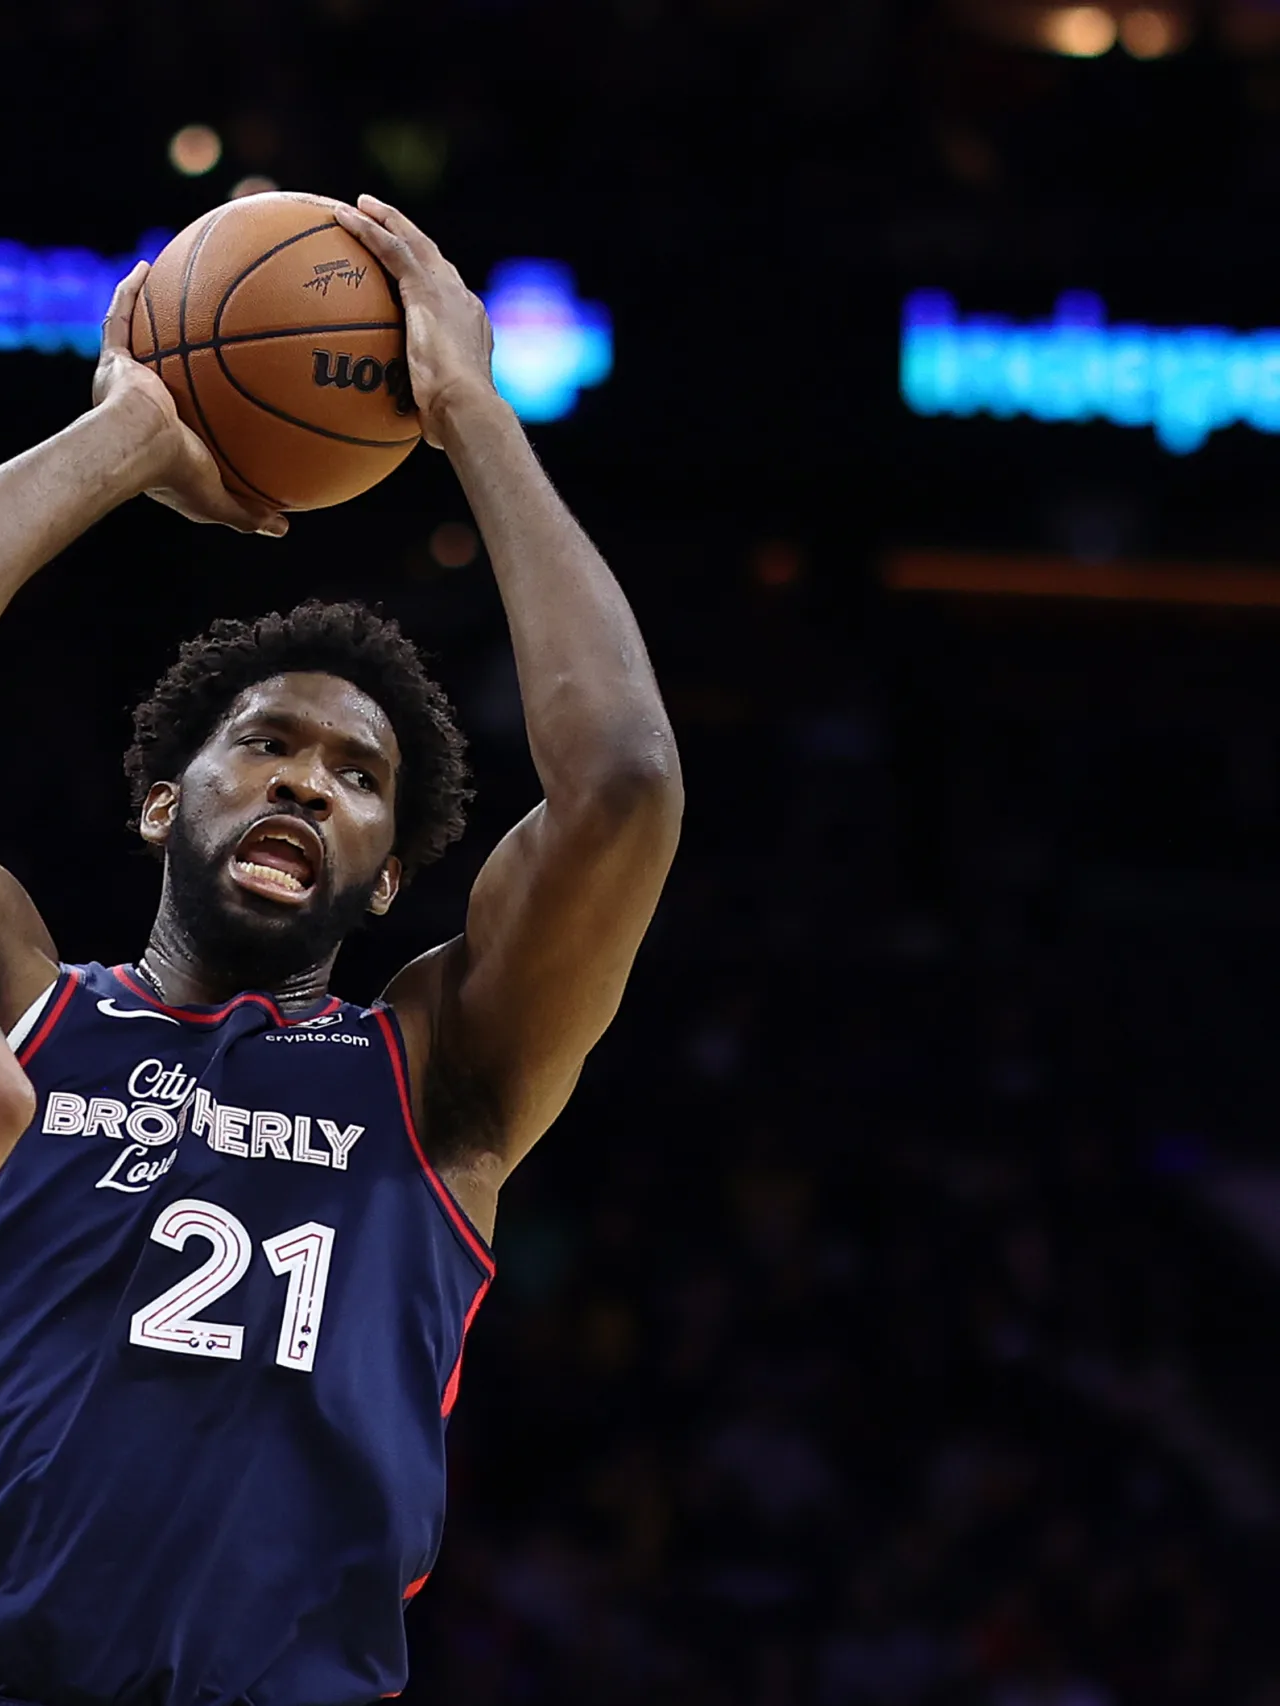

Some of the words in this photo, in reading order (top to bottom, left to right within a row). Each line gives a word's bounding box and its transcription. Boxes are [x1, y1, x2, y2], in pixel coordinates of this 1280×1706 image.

[265, 1032, 370, 1048] crypto.com
[127, 1058, 198, 1111] City
[41, 1087, 366, 1171] BROHERLY
[129, 1198, 336, 1373] 21
